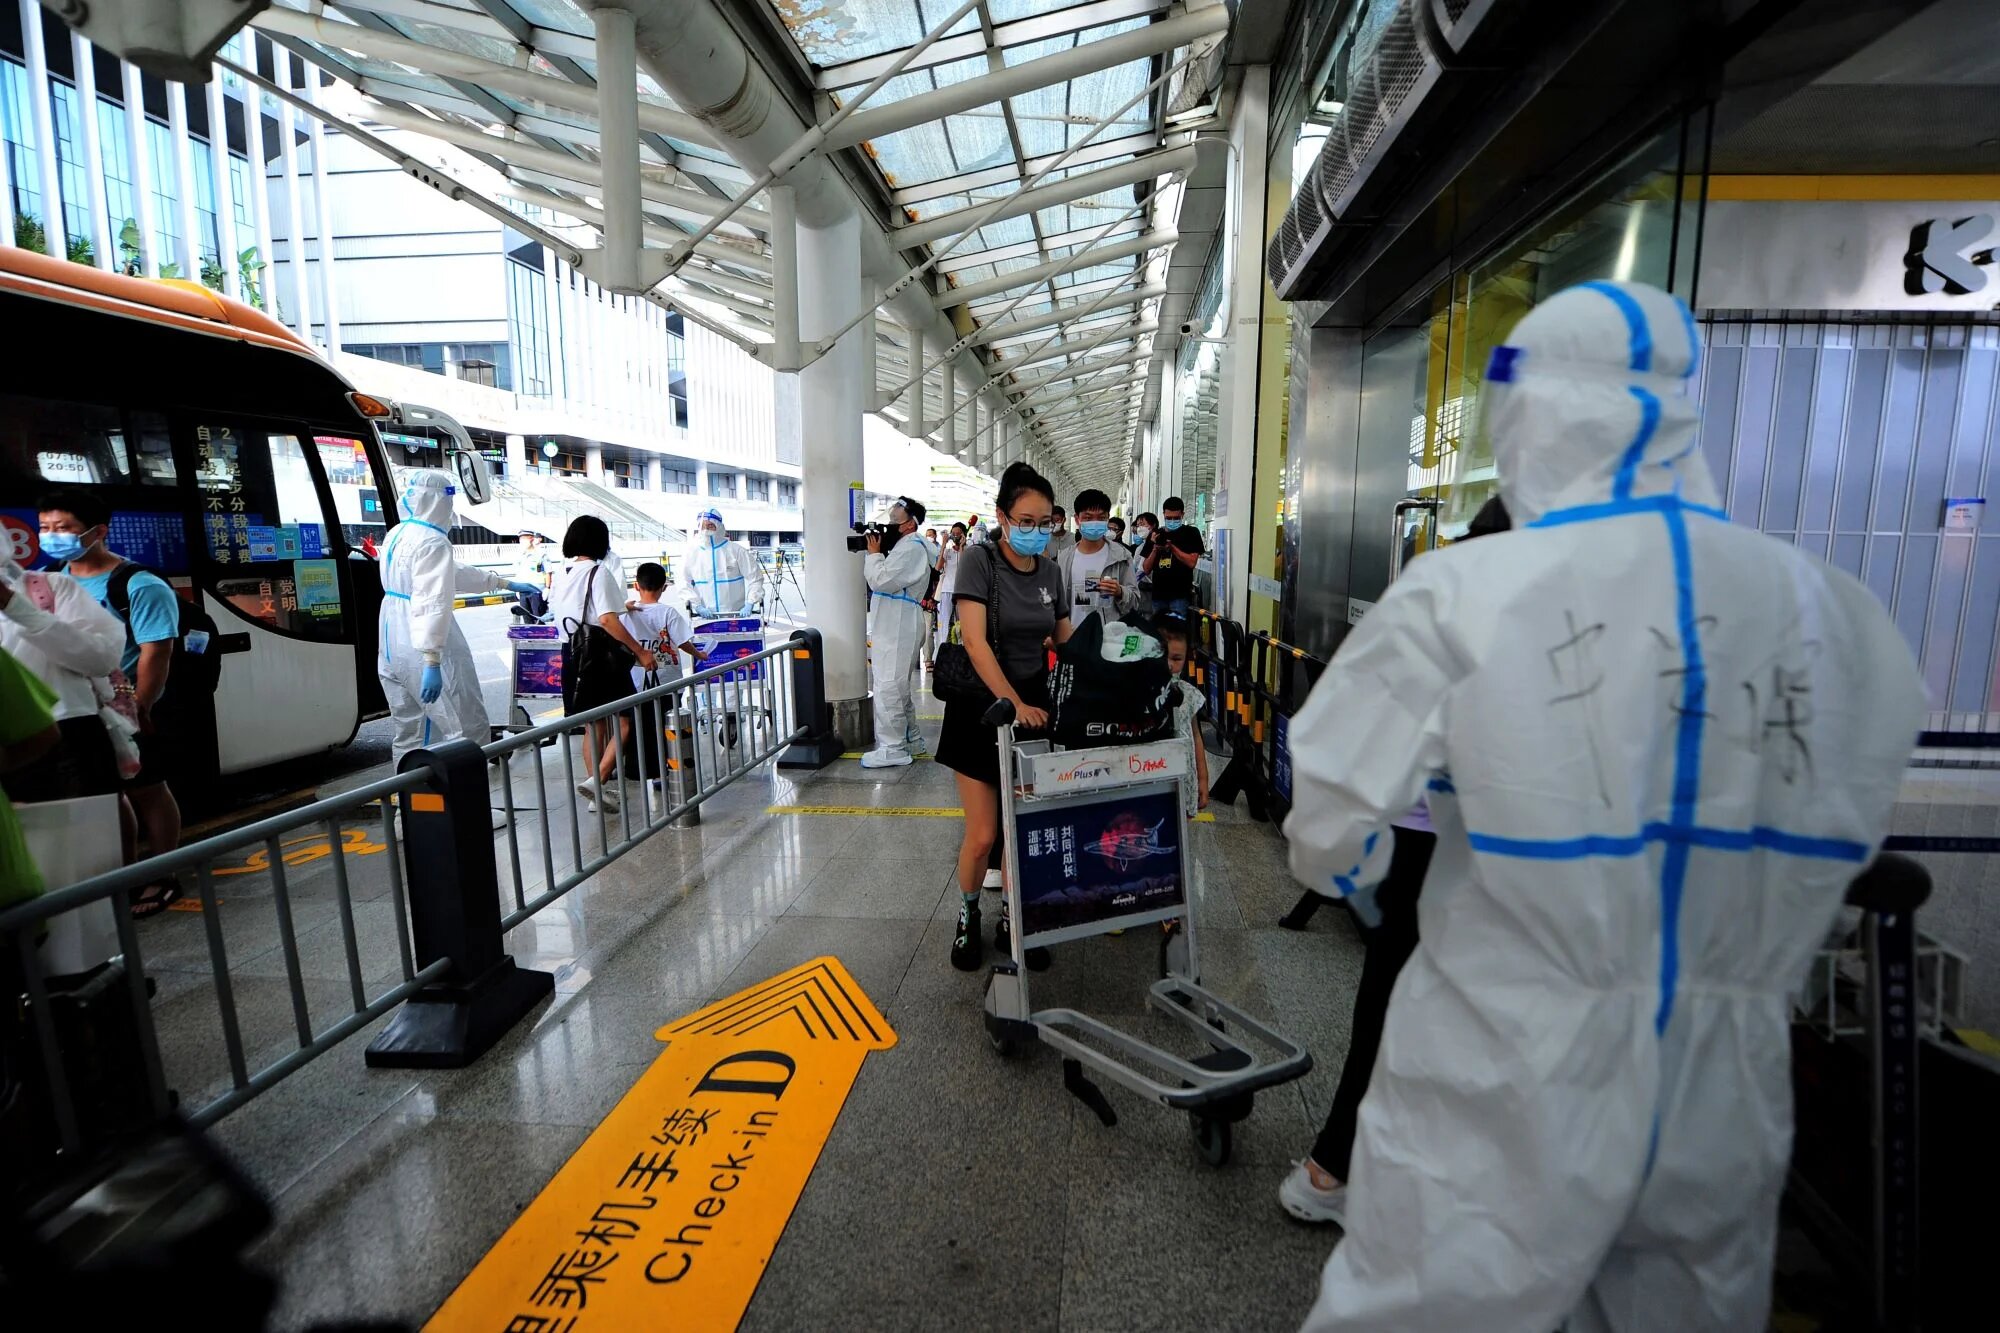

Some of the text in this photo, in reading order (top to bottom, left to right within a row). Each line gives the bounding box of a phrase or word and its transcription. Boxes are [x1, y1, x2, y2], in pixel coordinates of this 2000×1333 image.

[47, 462, 84, 472] 20:50
[197, 425, 231, 564] 自动投币不设找零
[1028, 830, 1039, 857] 温暖
[1044, 827, 1056, 855] 强大
[1061, 825, 1074, 878] 共同成长
[689, 1050, 796, 1101] D
[644, 1110, 779, 1284] Check-in
